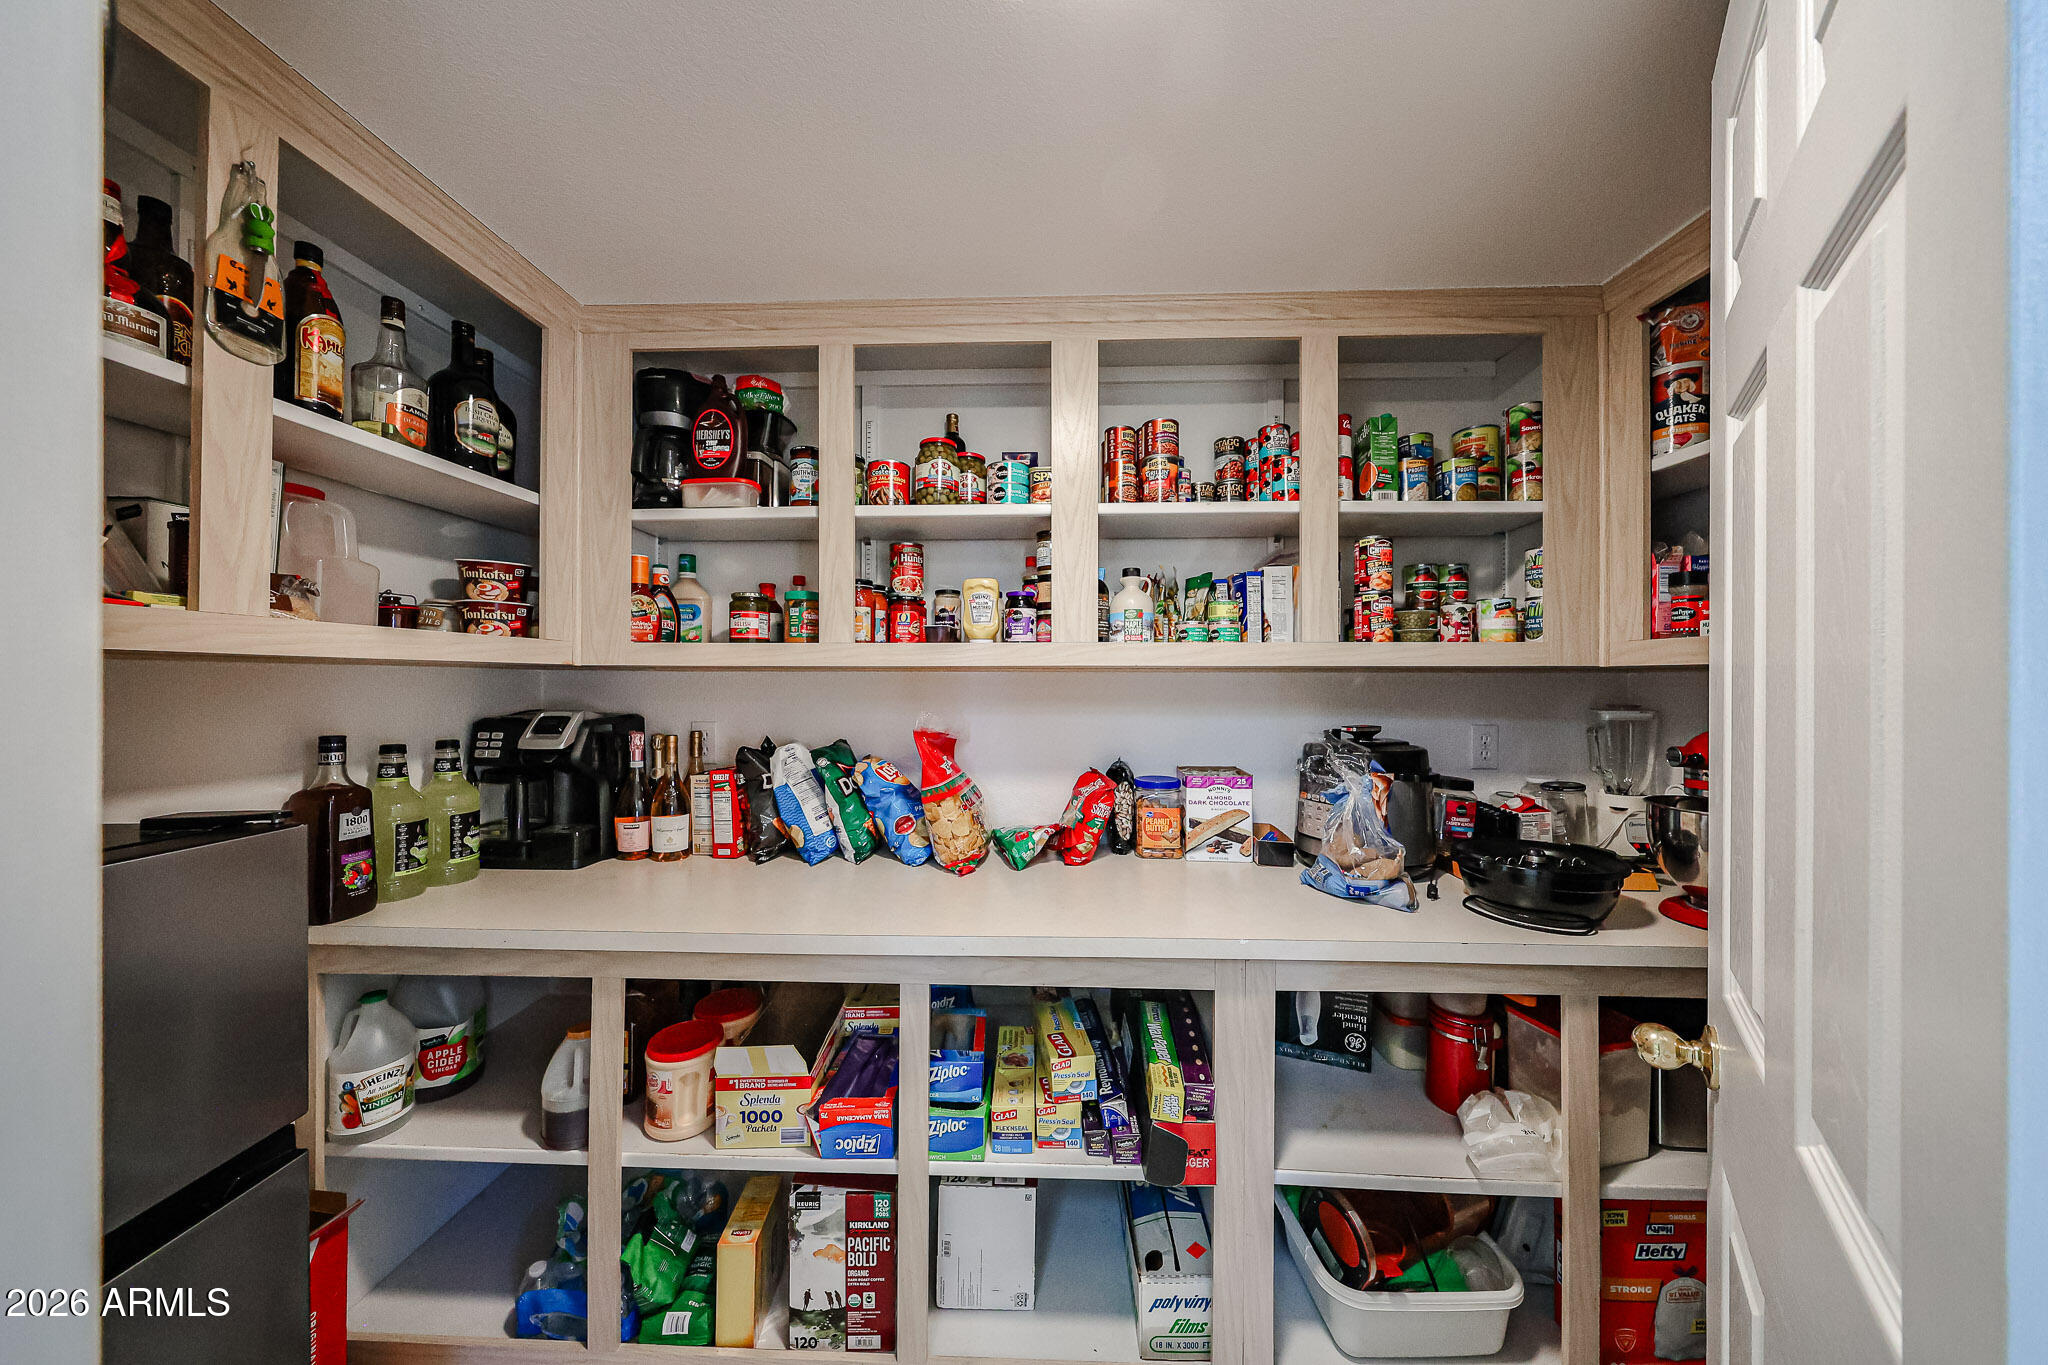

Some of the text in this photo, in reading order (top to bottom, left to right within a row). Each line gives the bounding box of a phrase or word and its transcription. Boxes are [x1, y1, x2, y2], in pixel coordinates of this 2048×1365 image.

[115, 313, 158, 337] Marnier
[301, 326, 345, 357] KAHL
[1655, 403, 1706, 422] QUAKER
[1665, 413, 1697, 426] OATS
[696, 429, 731, 441] HERSHEY'S
[1214, 438, 1239, 447] STAGG
[1034, 471, 1051, 481] SPA
[461, 565, 513, 581] Tonkotsu
[462, 607, 515, 621] Tonkotsu
[1124, 621, 1142, 629] MAPLE
[1124, 628, 1142, 636] SYRUP
[319, 753, 343, 762] 1800
[345, 814, 368, 827] 1800
[1145, 817, 1170, 825] PEANUT
[1145, 824, 1169, 832] BUTTER
[931, 996, 955, 1009] Ziplo
[1332, 1012, 1367, 1024] Blender
[845, 1021, 879, 1033] Splenda
[1342, 1022, 1367, 1032] Hand
[1051, 1033, 1073, 1057] GLAD
[1147, 1023, 1172, 1063] Wax Paper
[427, 1045, 463, 1060] APPLE
[427, 1055, 462, 1069] CIDER
[1052, 1061, 1071, 1071] GLAD
[431, 1064, 458, 1074] VINEGAR
[930, 1065, 968, 1084] Ziploc
[366, 1068, 401, 1087] HEINZ
[728, 1079, 739, 1089] #1
[378, 1079, 400, 1092] Natural
[361, 1090, 404, 1111] VINEGAR
[740, 1093, 781, 1107] Splenda
[1162, 1095, 1171, 1114] Wax
[1169, 1094, 1179, 1119] Paper
[739, 1110, 783, 1123] 1000
[993, 1111, 1017, 1121] GLAD
[1037, 1106, 1056, 1116] GLAD
[930, 1120, 967, 1137] Ziploc
[835, 1135, 880, 1155] Ziploc
[1188, 1149, 1211, 1157] EAT
[874, 1199, 889, 1208] 120
[849, 1221, 890, 1229] KIRKLAND
[1648, 1224, 1673, 1235] Hefty
[847, 1237, 891, 1252] PACIFIC
[1637, 1245, 1684, 1259] Hefty
[847, 1252, 878, 1267] BOLD
[847, 1269, 870, 1277] ORGANIC
[1609, 1284, 1653, 1294] STRONG
[1148, 1294, 1212, 1313] polyviny
[794, 1337, 818, 1349] 120
[1155, 1341, 1163, 1349] 18
[1165, 1341, 1175, 1349] IN.
